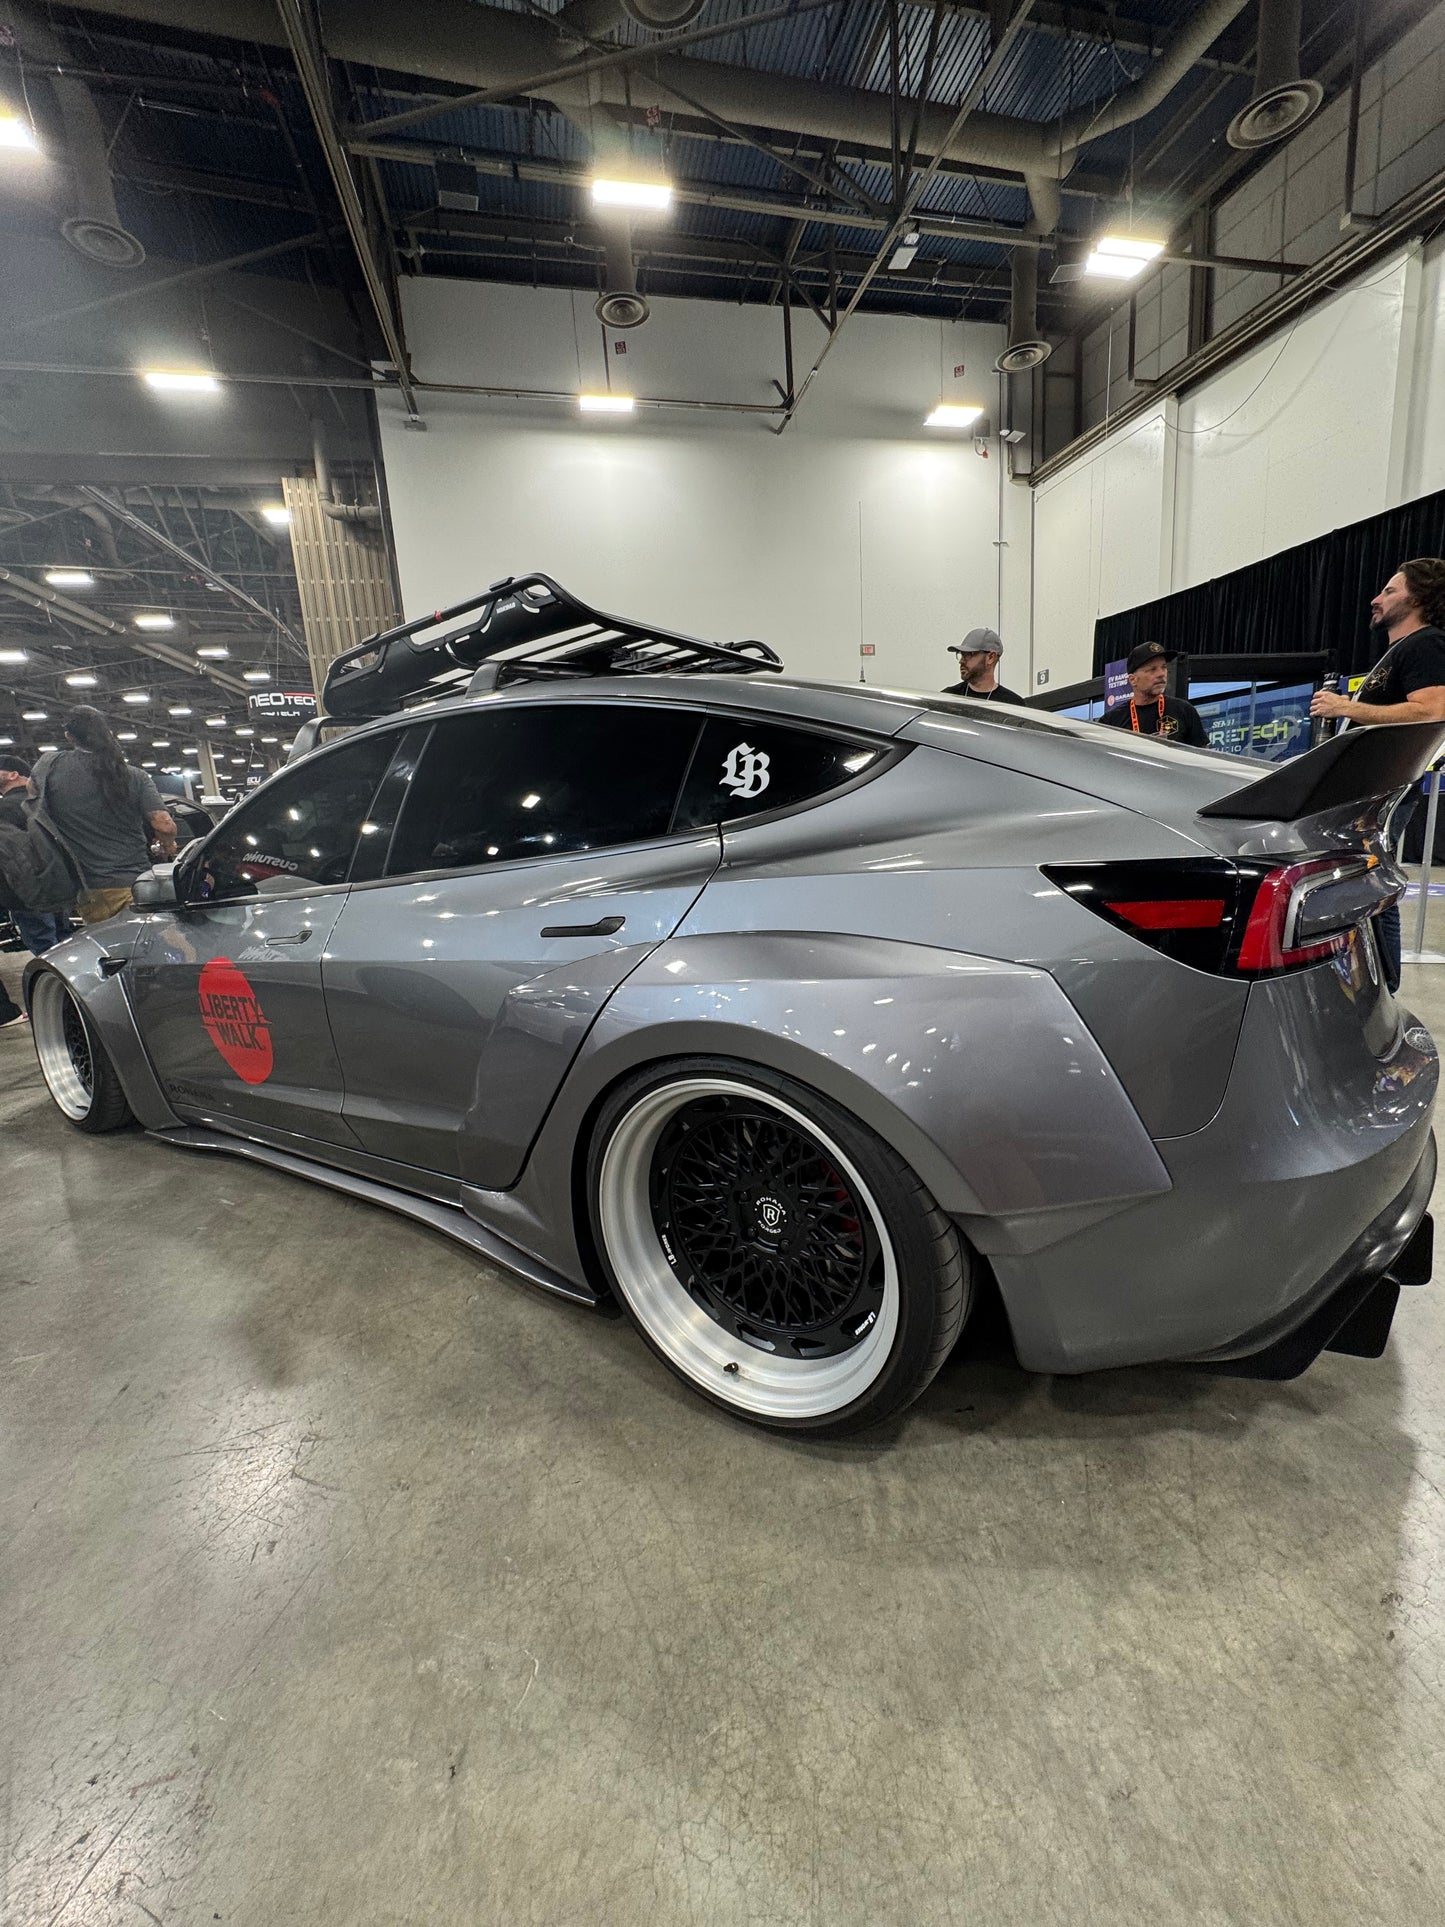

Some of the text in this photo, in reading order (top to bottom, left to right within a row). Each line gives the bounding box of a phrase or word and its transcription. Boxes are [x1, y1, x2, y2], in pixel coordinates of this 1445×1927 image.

[719, 742, 770, 798] LB
[199, 993, 264, 1023] LIBERTY
[215, 1022, 264, 1050] WALK
